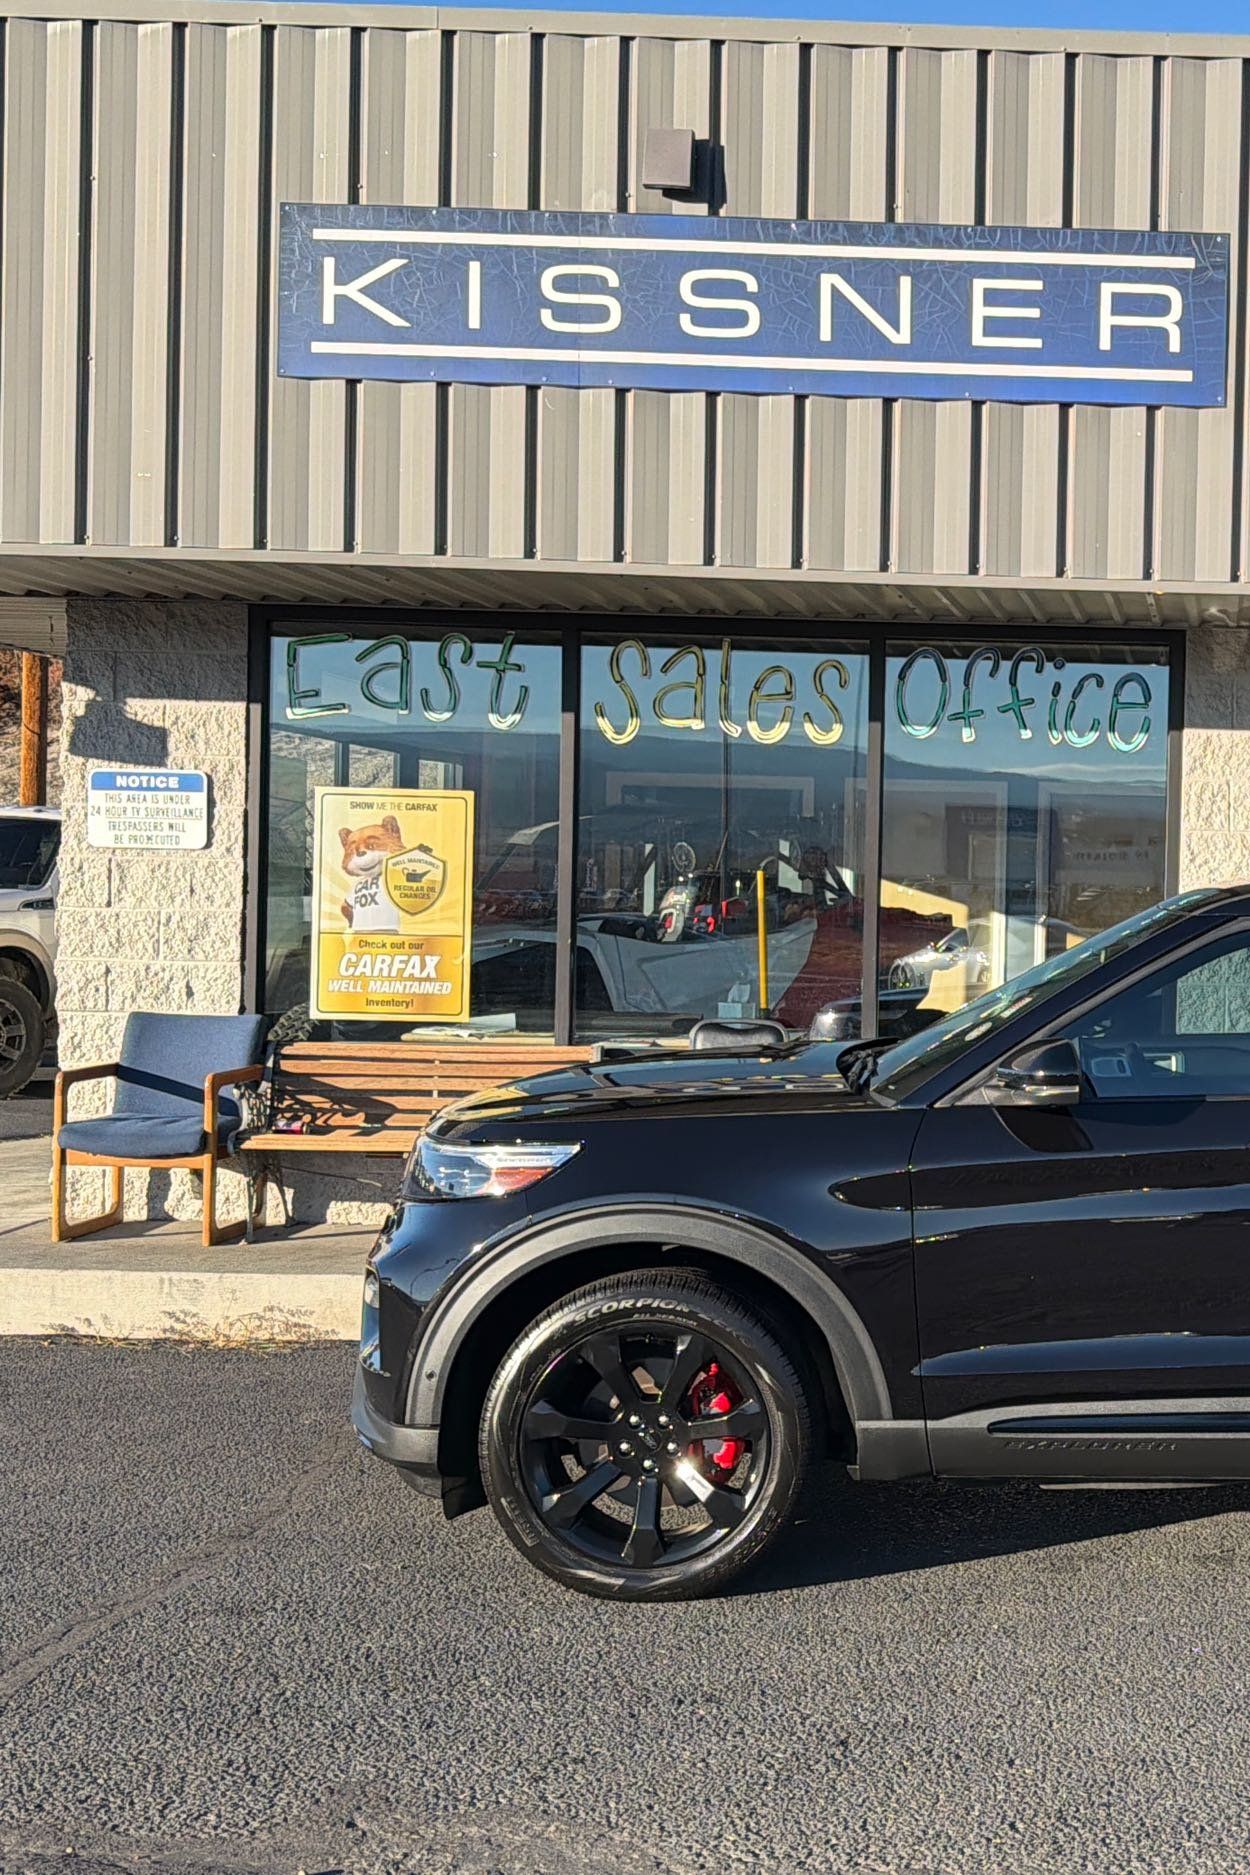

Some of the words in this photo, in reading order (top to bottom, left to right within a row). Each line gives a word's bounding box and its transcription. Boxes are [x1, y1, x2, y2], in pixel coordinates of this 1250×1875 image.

[321, 256, 1182, 353] KISSNER
[285, 630, 530, 730] East
[595, 637, 850, 746] Sales
[897, 645, 1154, 754] Office
[116, 775, 180, 789] NOTICE
[105, 793, 122, 804] THIS
[126, 793, 147, 804] AREA
[151, 794, 159, 804] IS
[163, 794, 191, 805] UNDER
[90, 806, 101, 816] 24
[105, 806, 127, 817] HOUR
[131, 806, 141, 817] TV
[144, 807, 204, 818] SURVEILLANCE
[350, 801, 375, 811] SHOW
[376, 802, 389, 811] ME
[390, 802, 404, 811] THE
[405, 802, 438, 812] CARFAX
[108, 821, 165, 833] TRESPASSERS
[168, 822, 187, 833] WILL
[114, 834, 123, 845] BE
[128, 834, 181, 846] PROSECUTED
[354, 877, 381, 895] CAR
[353, 892, 380, 910] FOX
[358, 939, 387, 950] Check
[390, 941, 406, 950] out
[408, 942, 425, 950] our
[338, 953, 441, 979] CARFAX
[328, 979, 363, 993] WELL
[367, 980, 453, 995] MAINTAINED
[365, 998, 414, 1009] Inventory!
[574, 1298, 690, 1327] SCORPION
